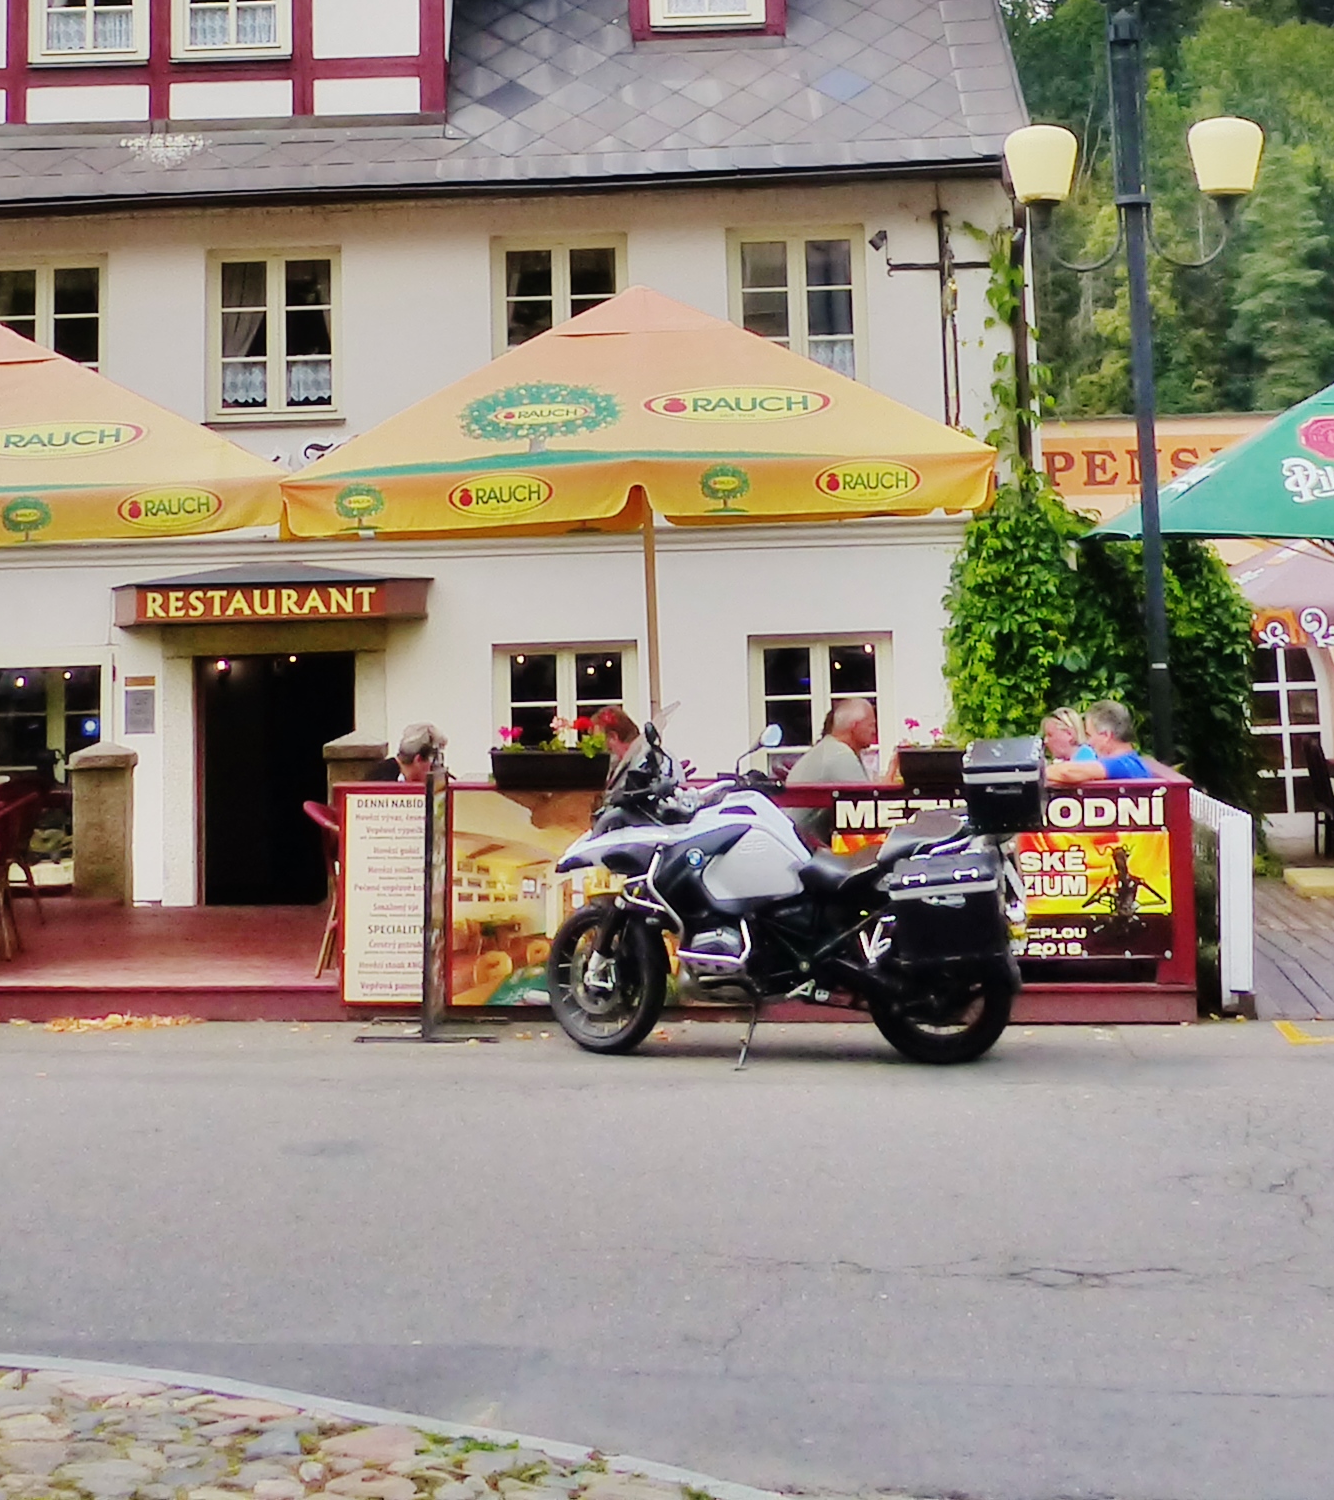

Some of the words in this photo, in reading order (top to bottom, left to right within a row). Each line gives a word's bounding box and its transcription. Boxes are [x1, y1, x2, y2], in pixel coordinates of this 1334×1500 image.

[692, 395, 809, 413] RAUCH
[517, 408, 578, 421] RAUCH
[3, 426, 122, 449] RAUCH
[842, 471, 908, 490] RAUCH
[475, 484, 542, 506] RAUCH
[143, 496, 212, 517] RAUCH
[145, 586, 377, 619] RESTAURANT
[357, 797, 389, 809] DENNÍ
[391, 797, 425, 809] NABÍD
[1019, 845, 1087, 873] SKÉ
[1023, 875, 1088, 897] ZIUM
[367, 924, 424, 935] SPECIALITY
[1027, 927, 1088, 940] EPLOU
